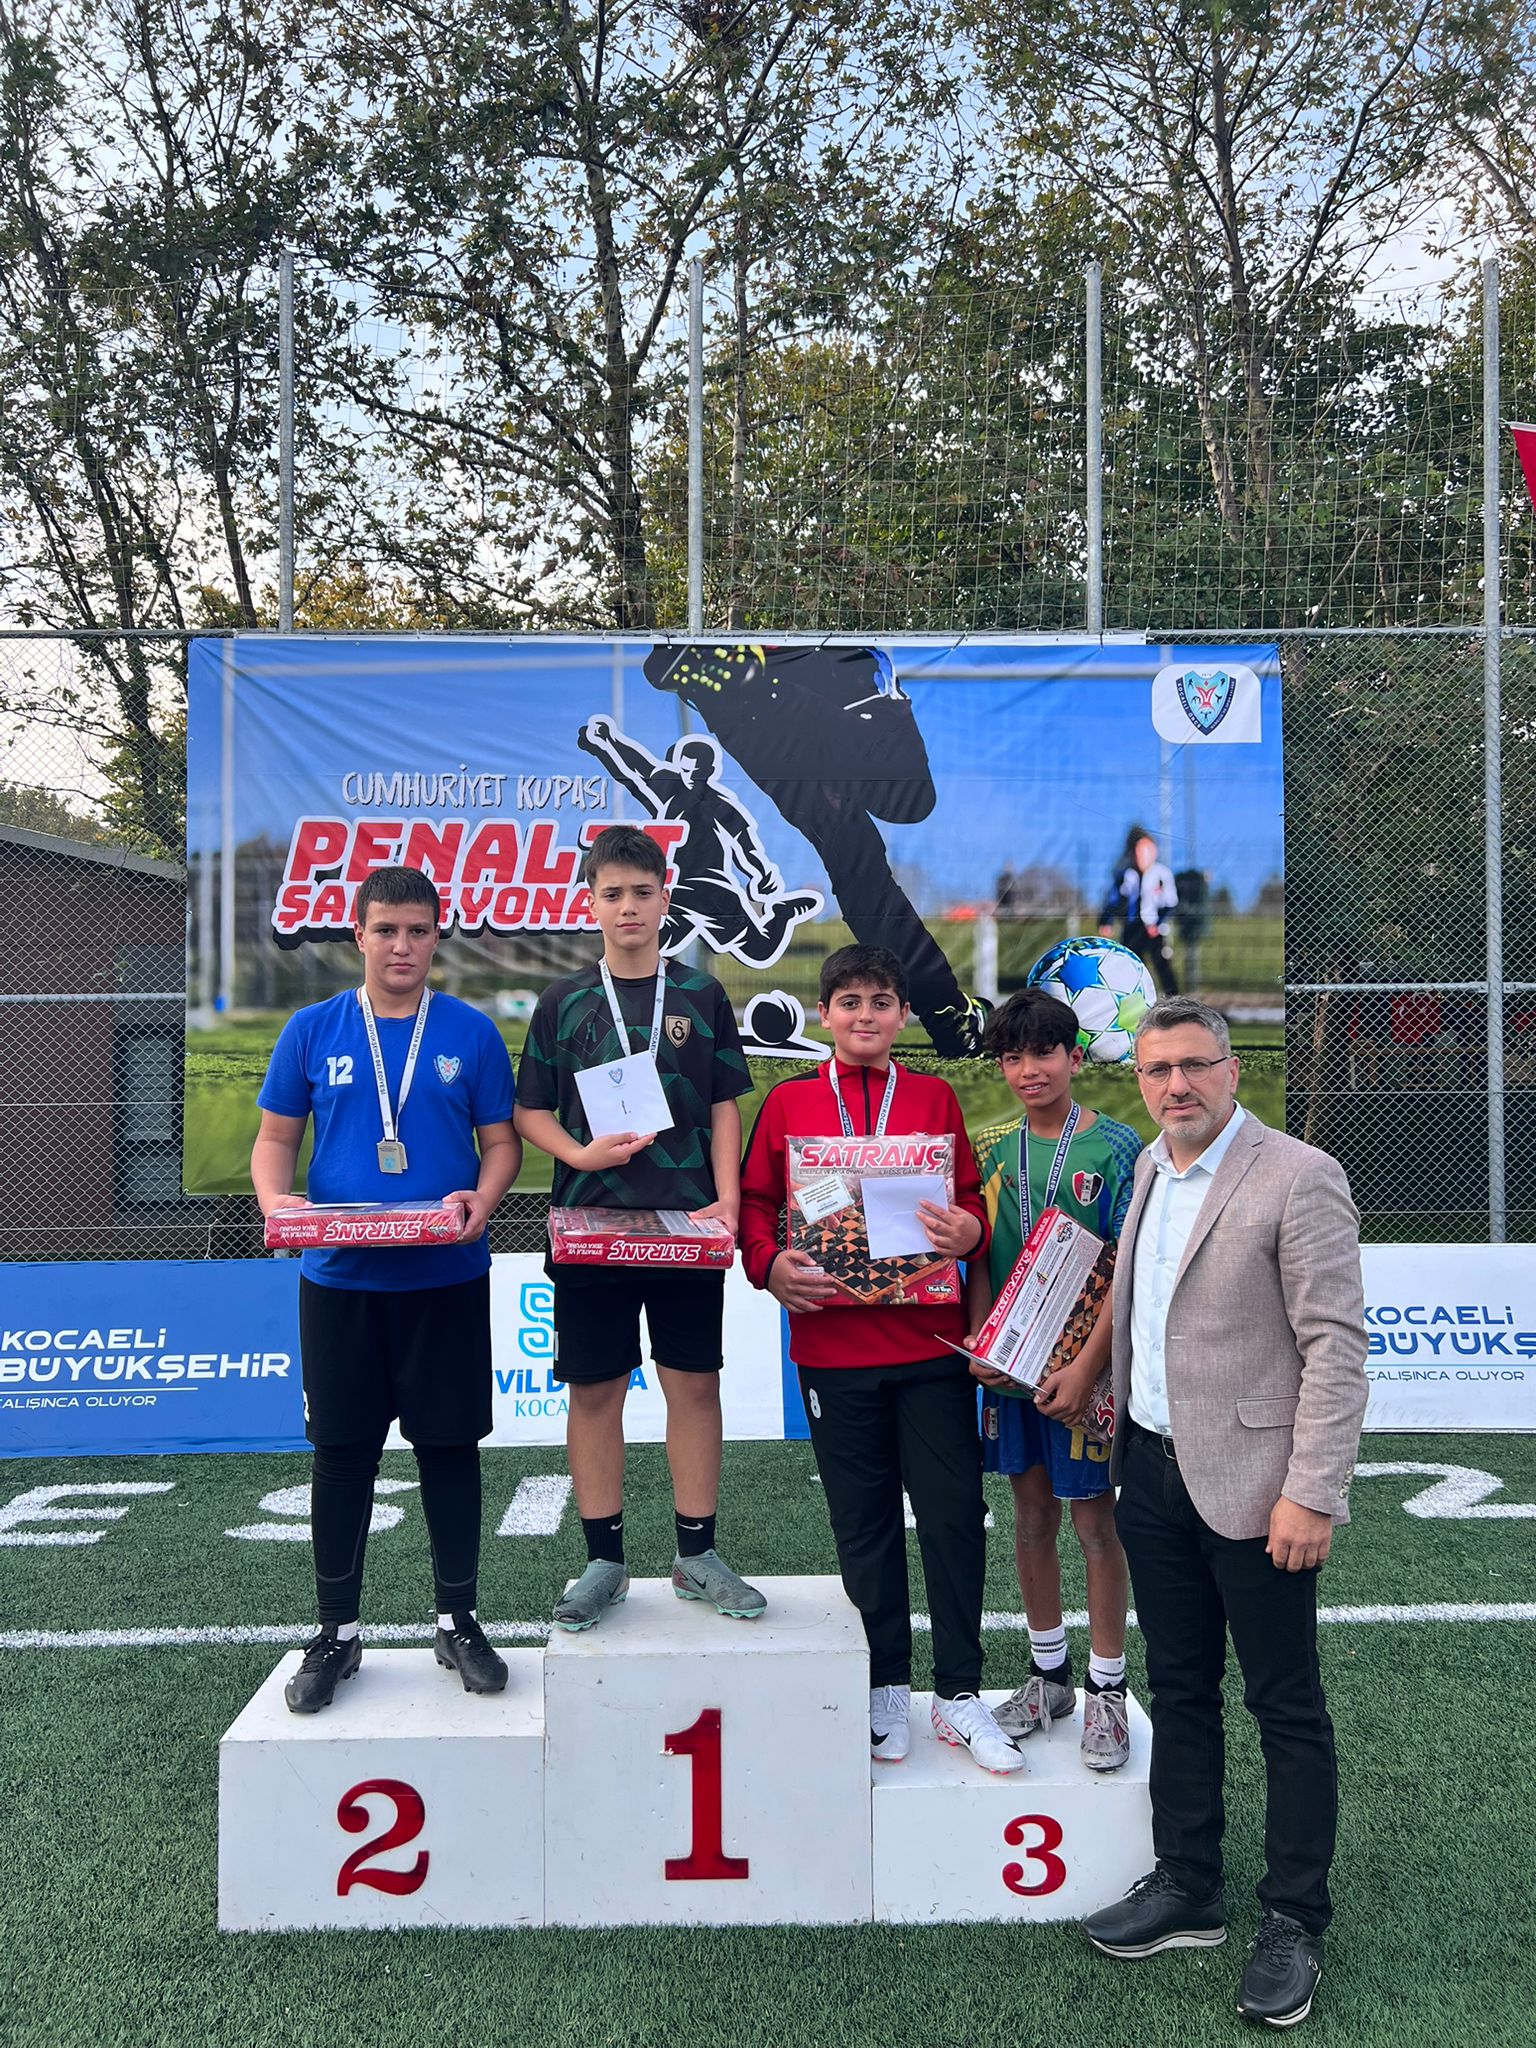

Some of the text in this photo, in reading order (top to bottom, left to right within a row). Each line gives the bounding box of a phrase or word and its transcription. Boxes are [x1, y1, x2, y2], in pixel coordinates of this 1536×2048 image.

[516, 774, 609, 811] KUPASI
[287, 819, 686, 884] PENAL
[327, 1055, 354, 1086] 12
[798, 1143, 949, 1172] SATRANÇ
[323, 1220, 423, 1241] SATRANÇ
[607, 1240, 701, 1262] SATRANÇ
[1455, 1370, 1526, 1382] OLUYOR
[0, 1395, 157, 1410] ALIŞINCA OLUYOR
[514, 1398, 569, 1418] KOCA
[809, 1388, 821, 1419] 8
[663, 1706, 750, 1882] 1
[336, 1778, 431, 1898] 2
[1001, 1813, 1067, 1898] 3
